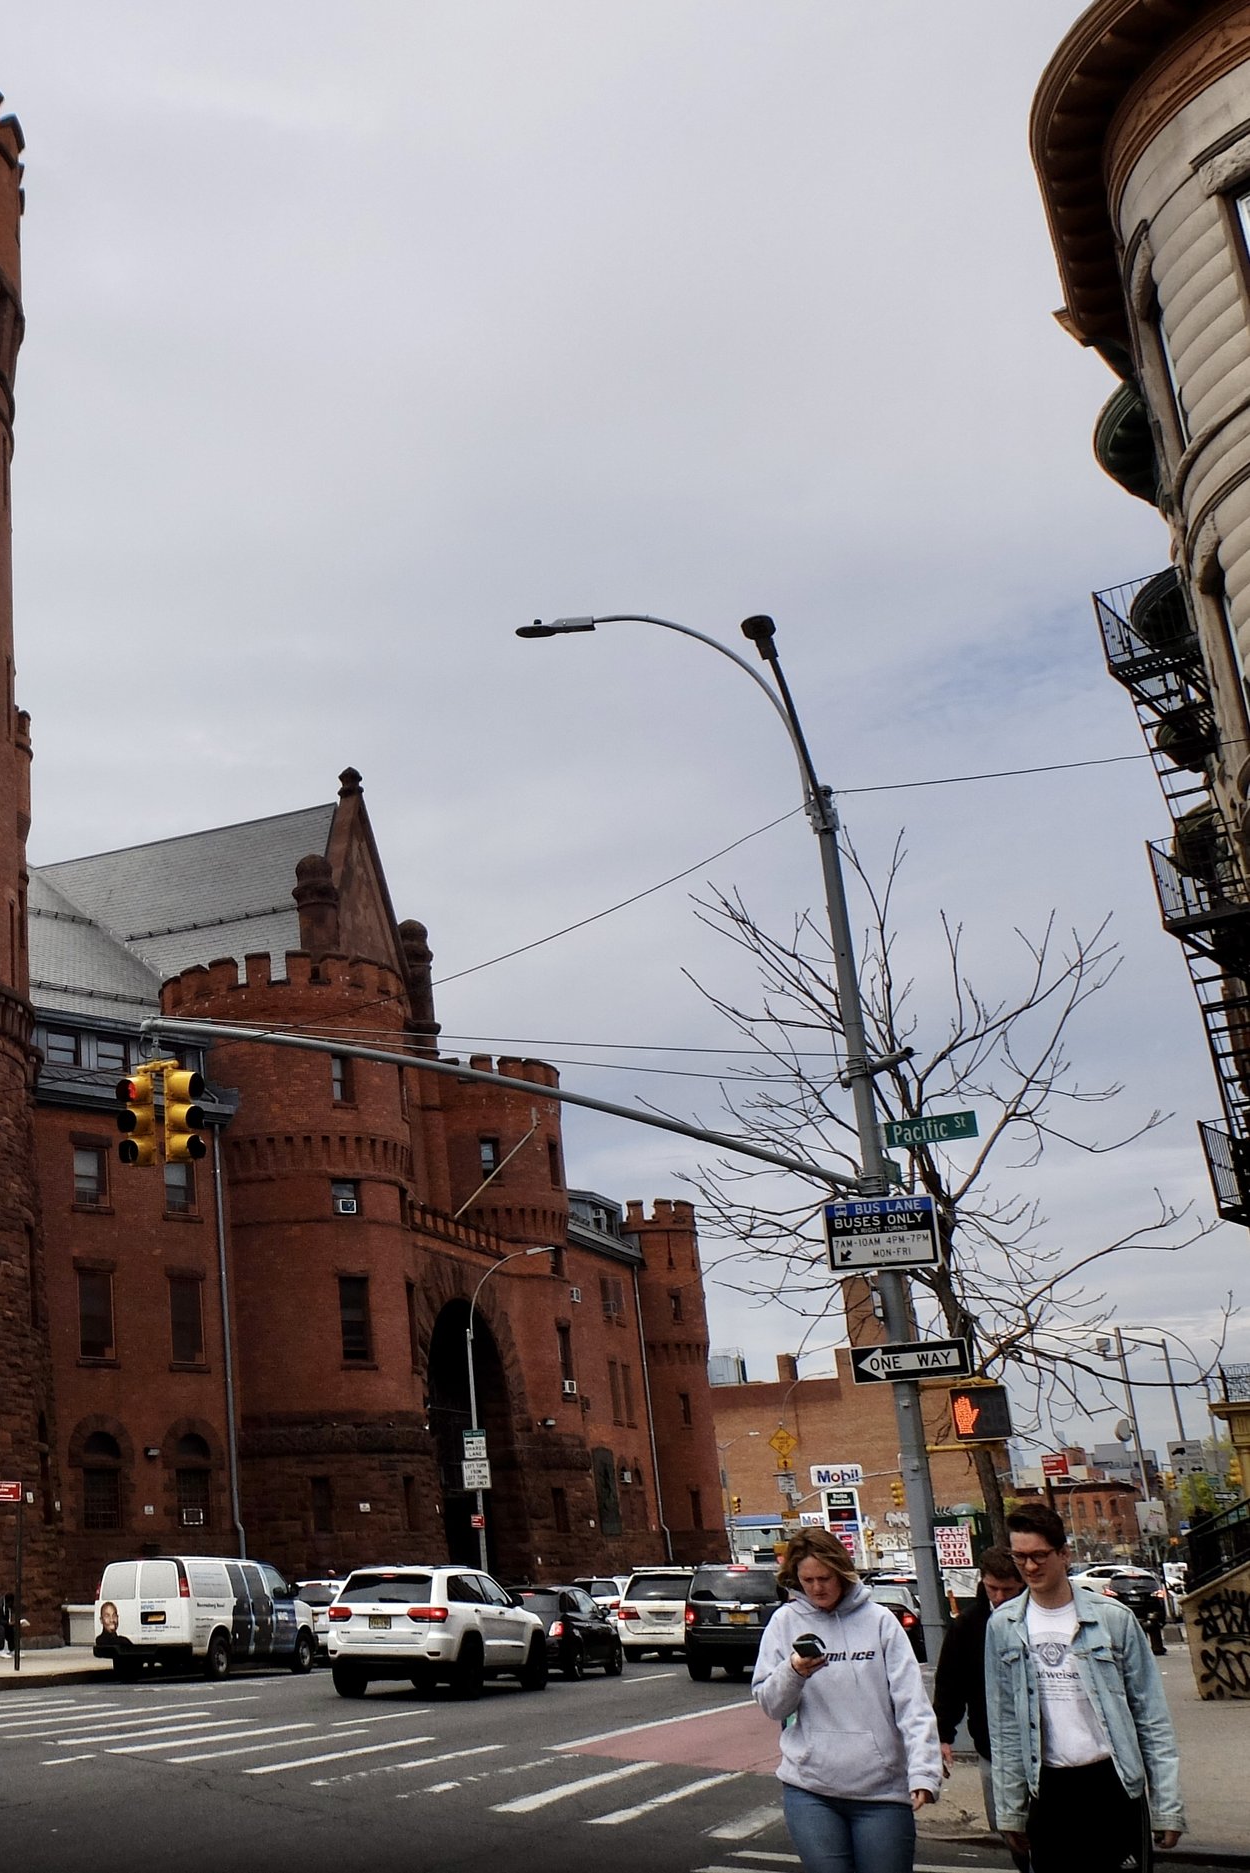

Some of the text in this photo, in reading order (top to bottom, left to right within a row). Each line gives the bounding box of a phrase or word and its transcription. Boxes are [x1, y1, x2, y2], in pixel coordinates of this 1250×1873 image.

[892, 1115, 967, 1143] Pacific St
[855, 1199, 922, 1215] BUS LANE
[834, 1212, 924, 1229] BUSES ONLY
[860, 1226, 881, 1234] RIGHT
[884, 1224, 908, 1232] TURNS
[834, 1233, 929, 1249] 7AM-10AM 4PM-7PM
[872, 1247, 912, 1258] MON-FRI
[870, 1351, 951, 1371] ONE WAY
[816, 1469, 860, 1485] Mobil
[802, 1515, 824, 1526] Mob
